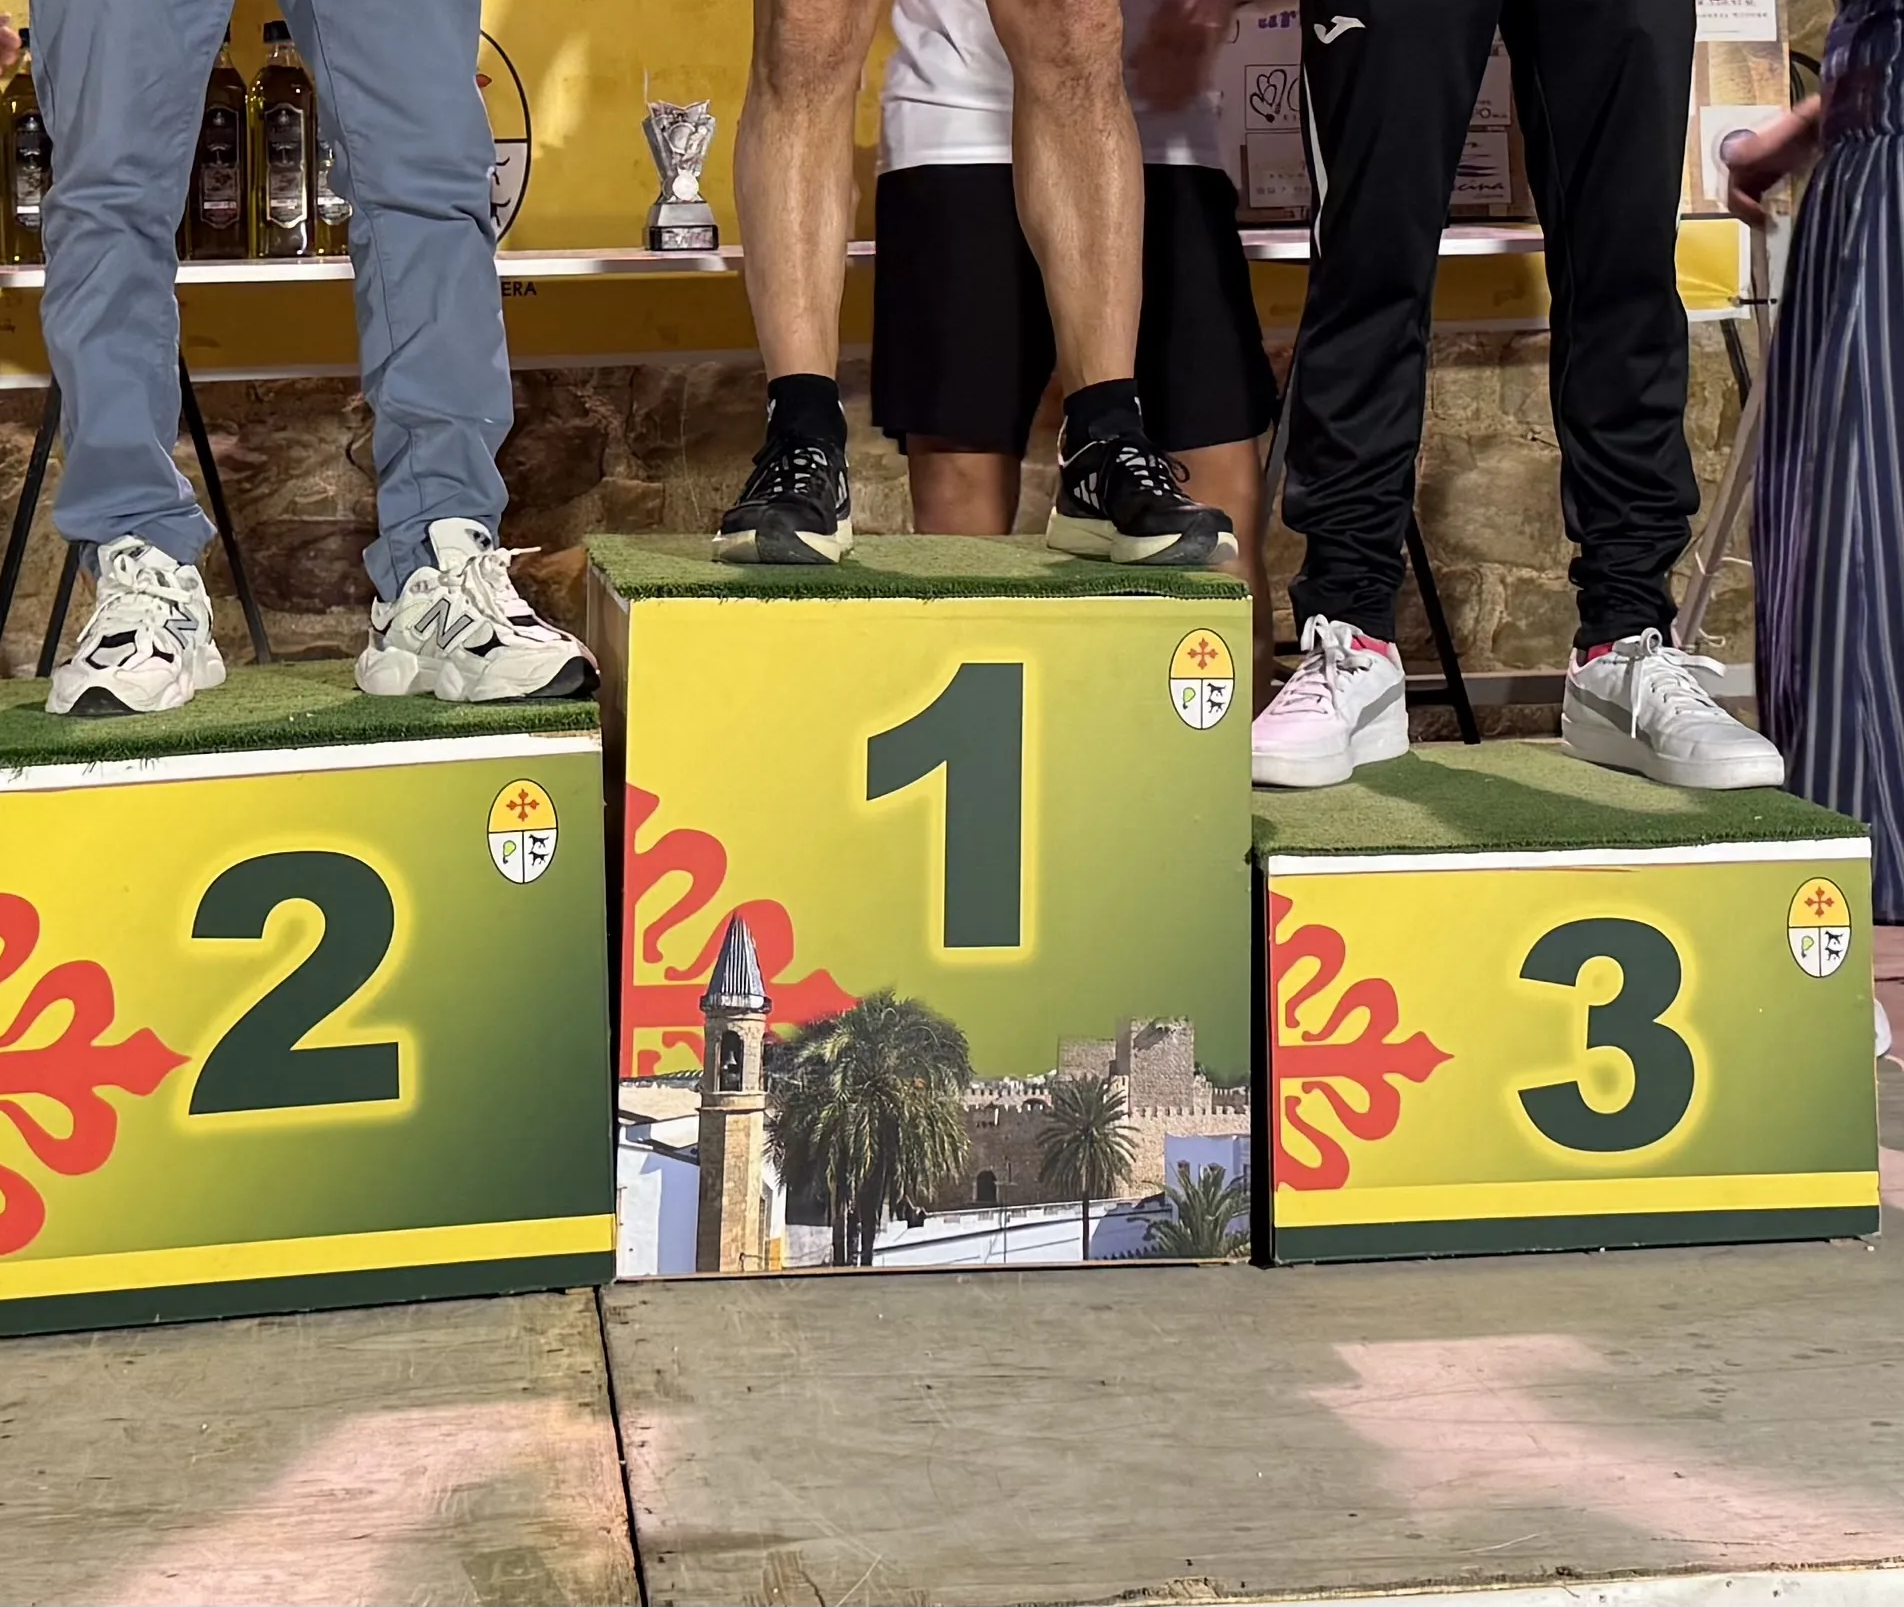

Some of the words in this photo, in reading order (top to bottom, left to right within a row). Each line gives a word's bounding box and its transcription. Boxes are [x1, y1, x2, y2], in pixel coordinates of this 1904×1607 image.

[500, 280, 537, 297] ERA
[865, 661, 1025, 949] 1
[187, 849, 402, 1117] 2
[1517, 916, 1696, 1153] 3
